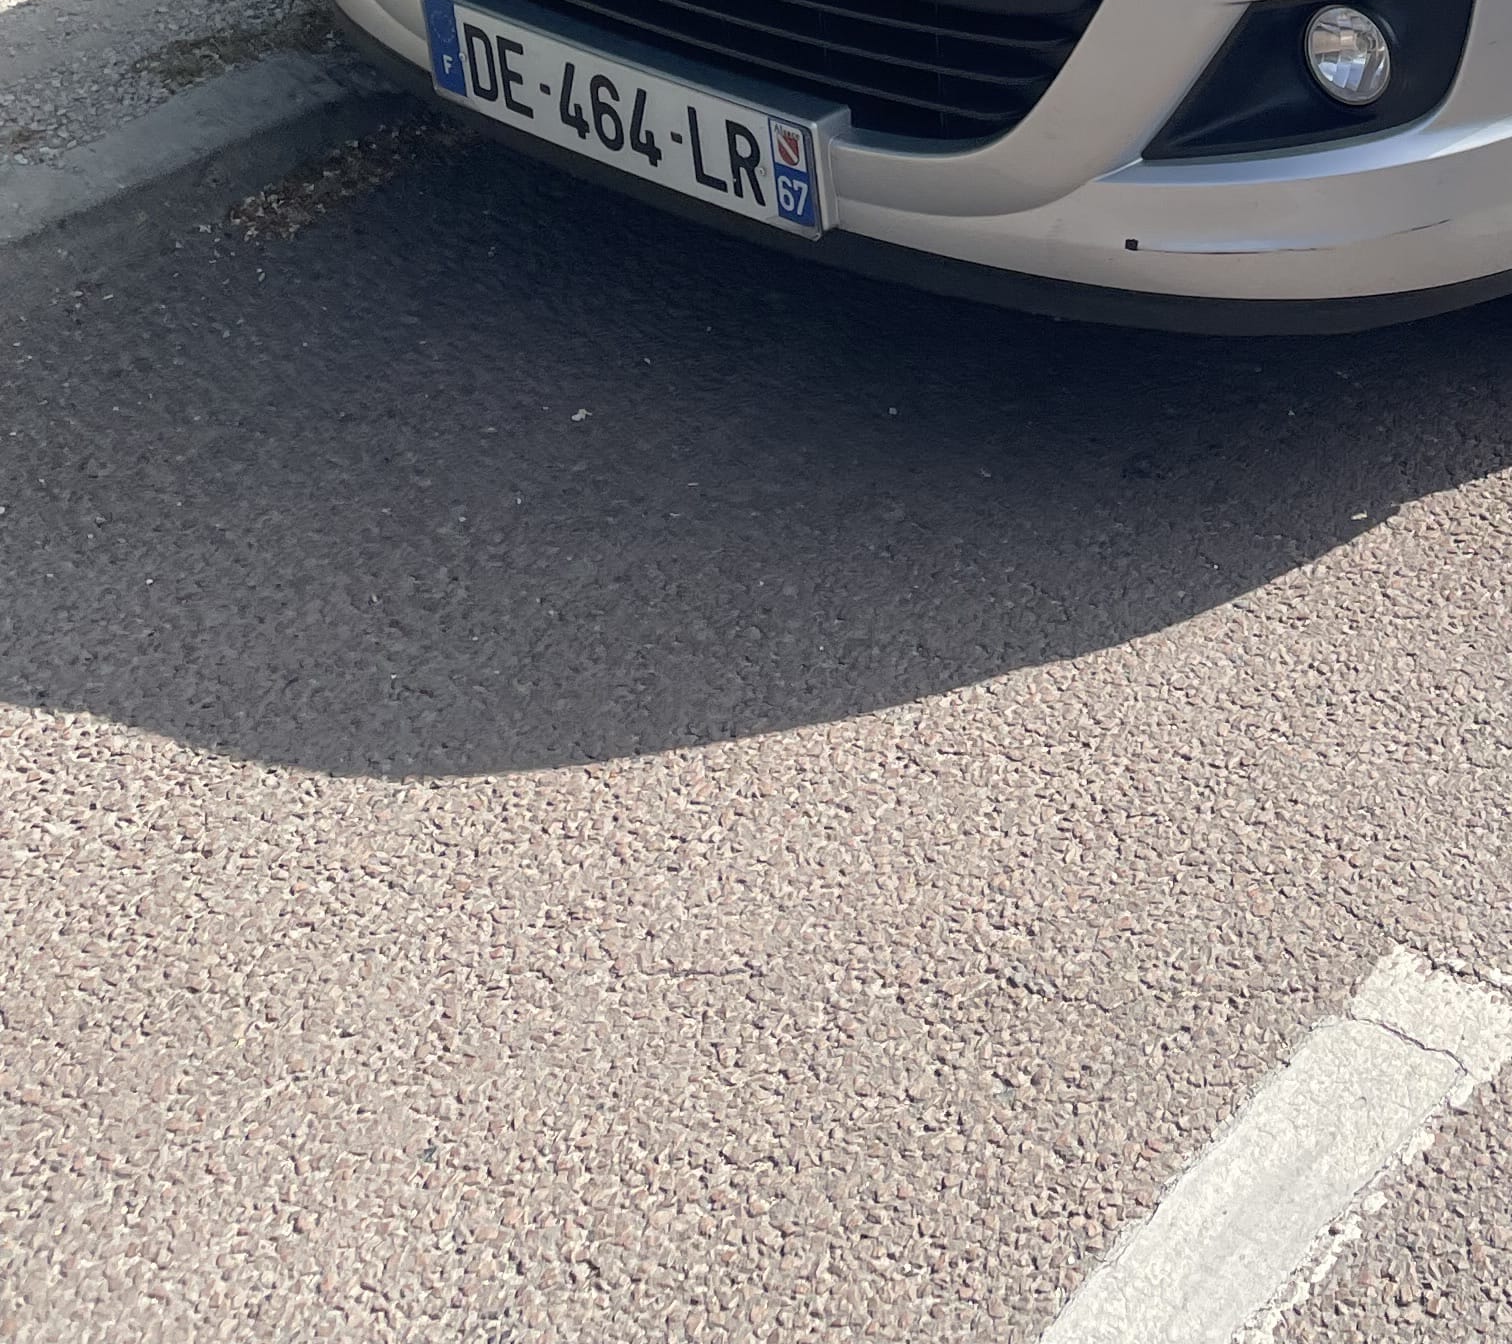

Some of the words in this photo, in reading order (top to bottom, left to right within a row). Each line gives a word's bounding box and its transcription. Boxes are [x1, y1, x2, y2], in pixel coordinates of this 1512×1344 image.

[443, 54, 453, 75] F
[463, 23, 766, 207] DE-464-LR
[777, 175, 808, 216] 67
